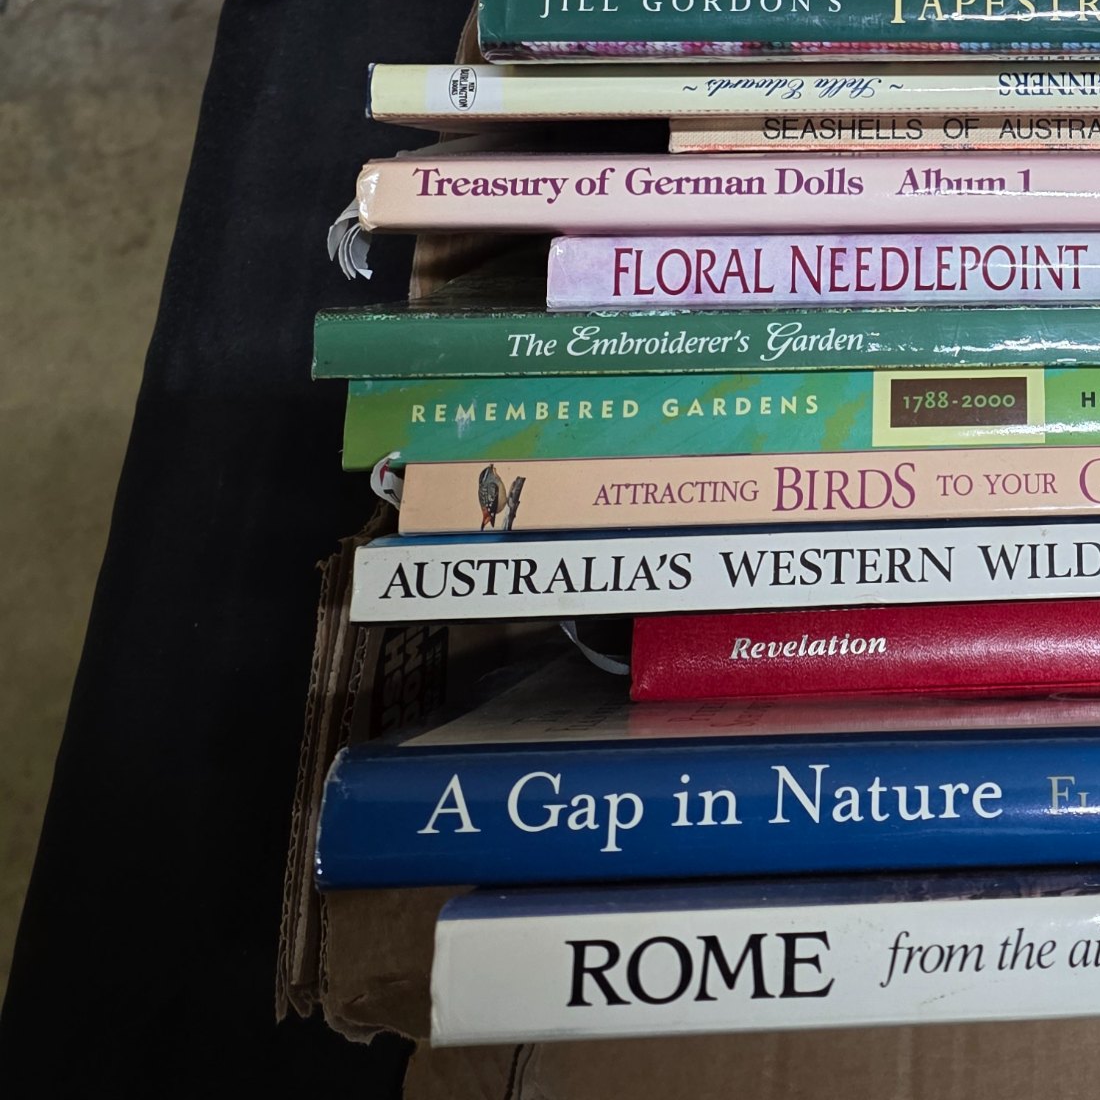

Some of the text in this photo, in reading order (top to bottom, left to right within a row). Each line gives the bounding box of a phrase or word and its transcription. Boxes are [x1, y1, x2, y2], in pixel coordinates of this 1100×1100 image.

[704, 76, 883, 101] Stella Edwards
[761, 117, 923, 141] SEASHELLS
[942, 117, 981, 141] OF
[411, 166, 1008, 204] Treasury of German Dolls Album
[612, 243, 1090, 297] FLORAL NEEDLEPOINT
[507, 320, 866, 363] The Garden
[410, 393, 822, 425] REMEMBERED GARDENS
[902, 390, 1017, 411] 1788-2000
[591, 479, 760, 508] ATTRACTING
[771, 462, 917, 513] BIRDS
[936, 474, 974, 497] TO
[981, 471, 1059, 496] YOUR
[718, 545, 957, 588] WESTERN
[728, 632, 888, 662] Revelation
[416, 762, 1005, 853] A Gap in Nature
[564, 929, 836, 1008] ROME
[879, 928, 985, 989] from
[997, 927, 1056, 973] the
